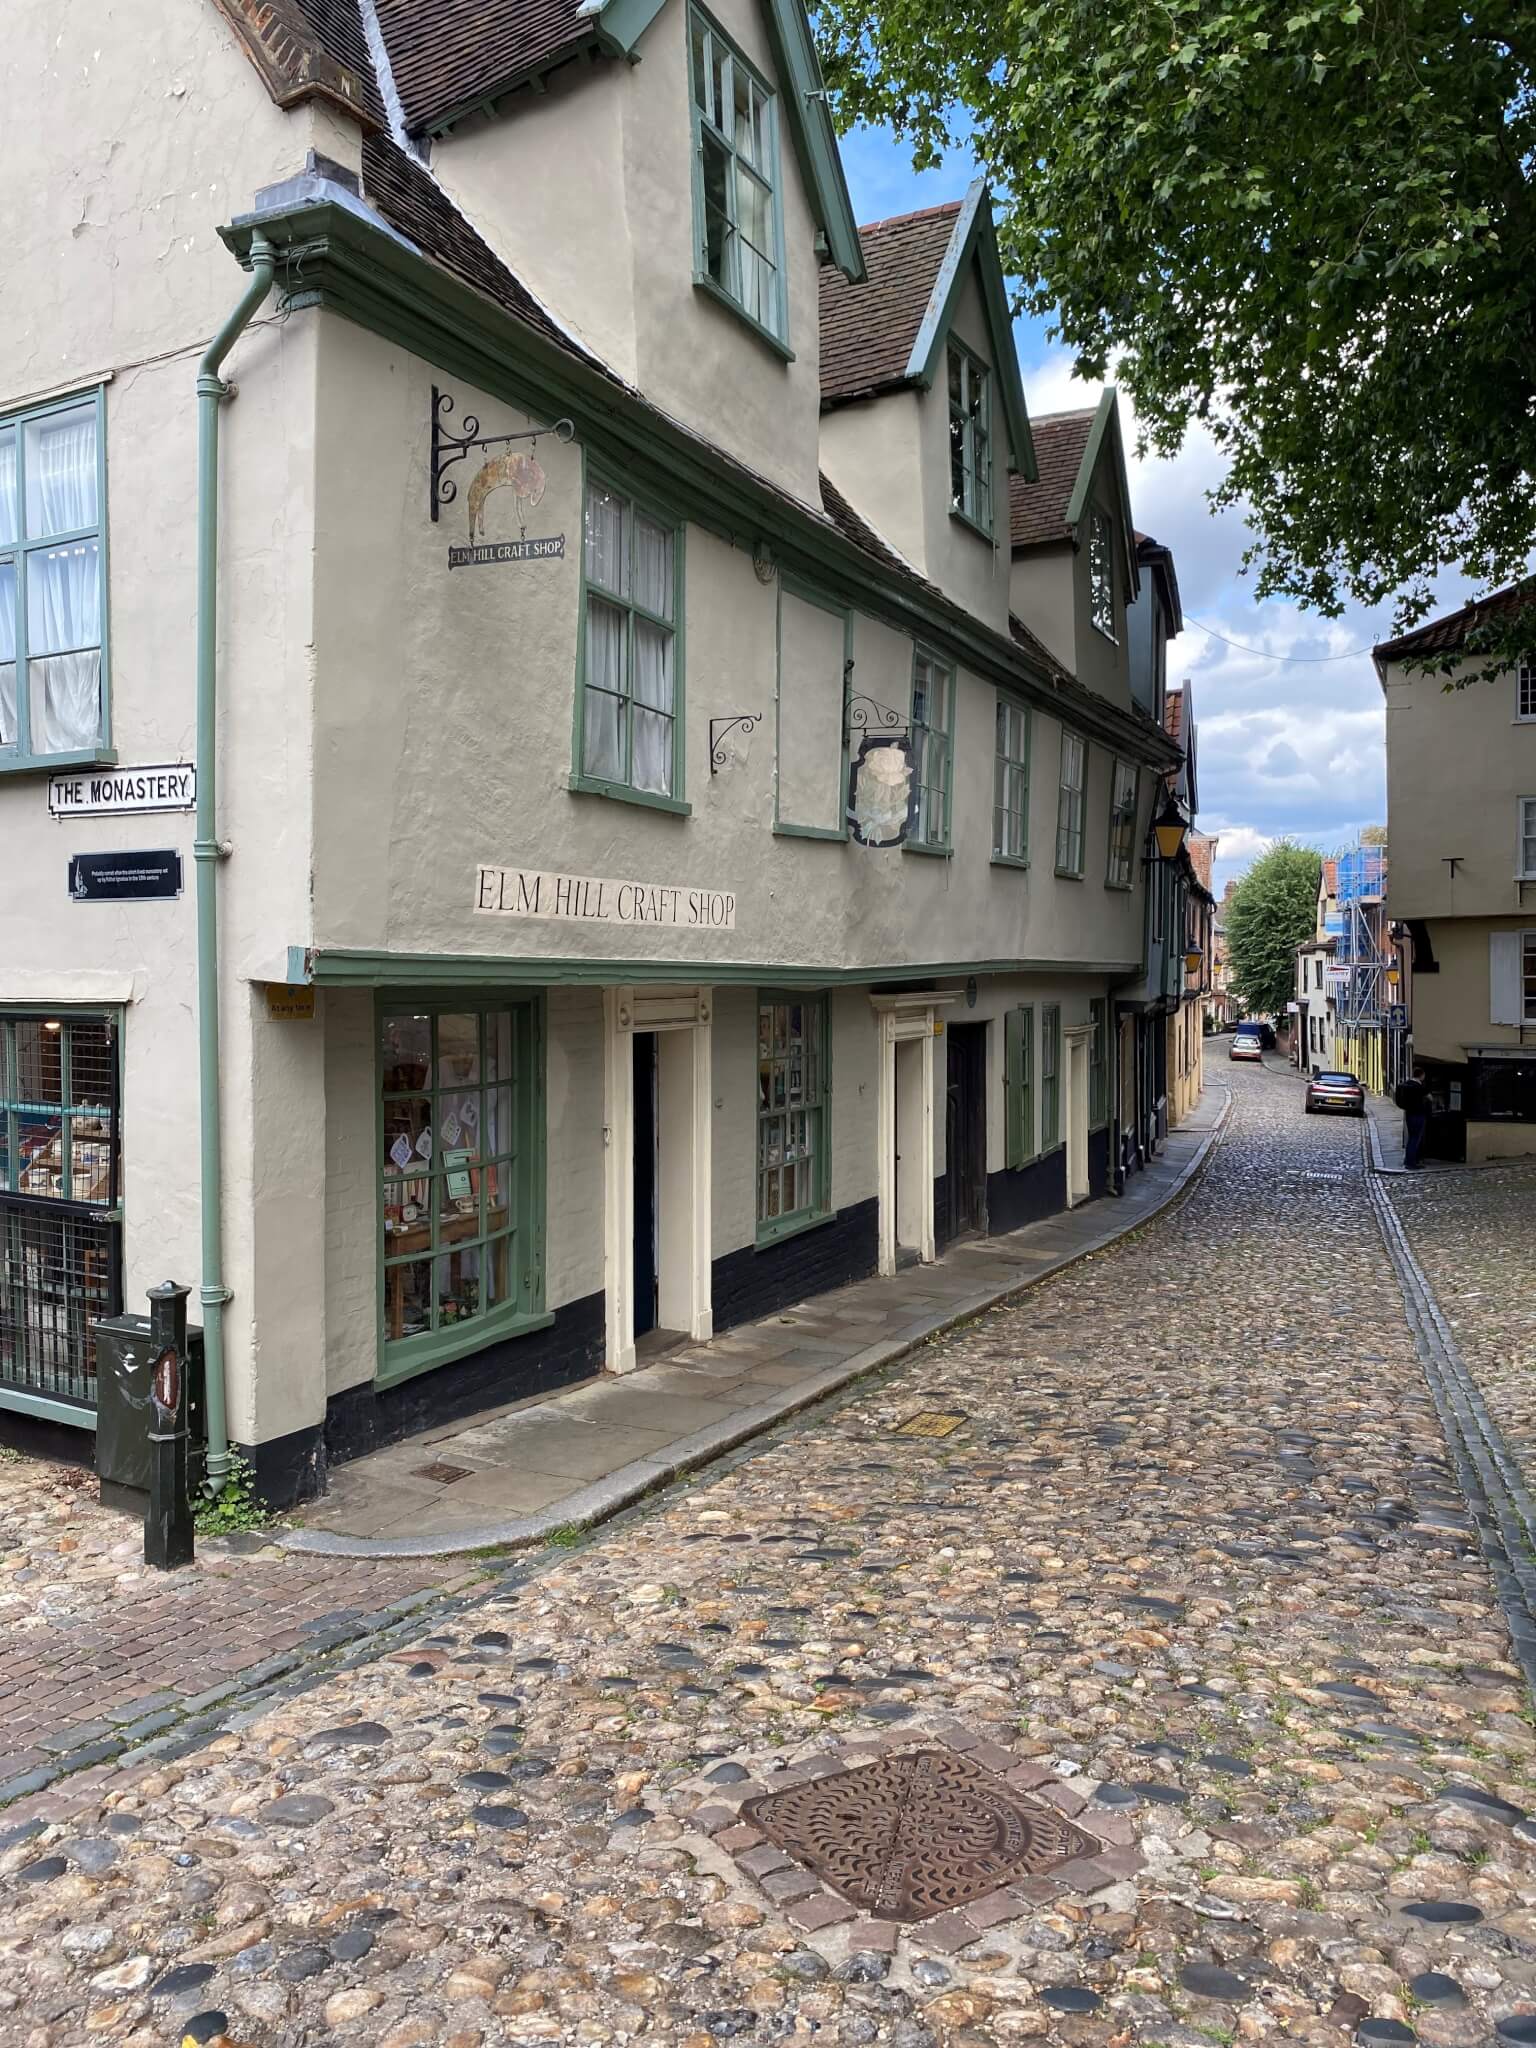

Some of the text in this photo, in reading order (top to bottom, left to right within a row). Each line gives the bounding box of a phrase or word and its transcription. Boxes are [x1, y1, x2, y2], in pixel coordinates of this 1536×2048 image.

[451, 541, 561, 563] ELM HILL CRAFT SHOP
[54, 774, 189, 805] THE MONASTERY
[478, 869, 735, 926] ELM HILL CRAFT SHOP
